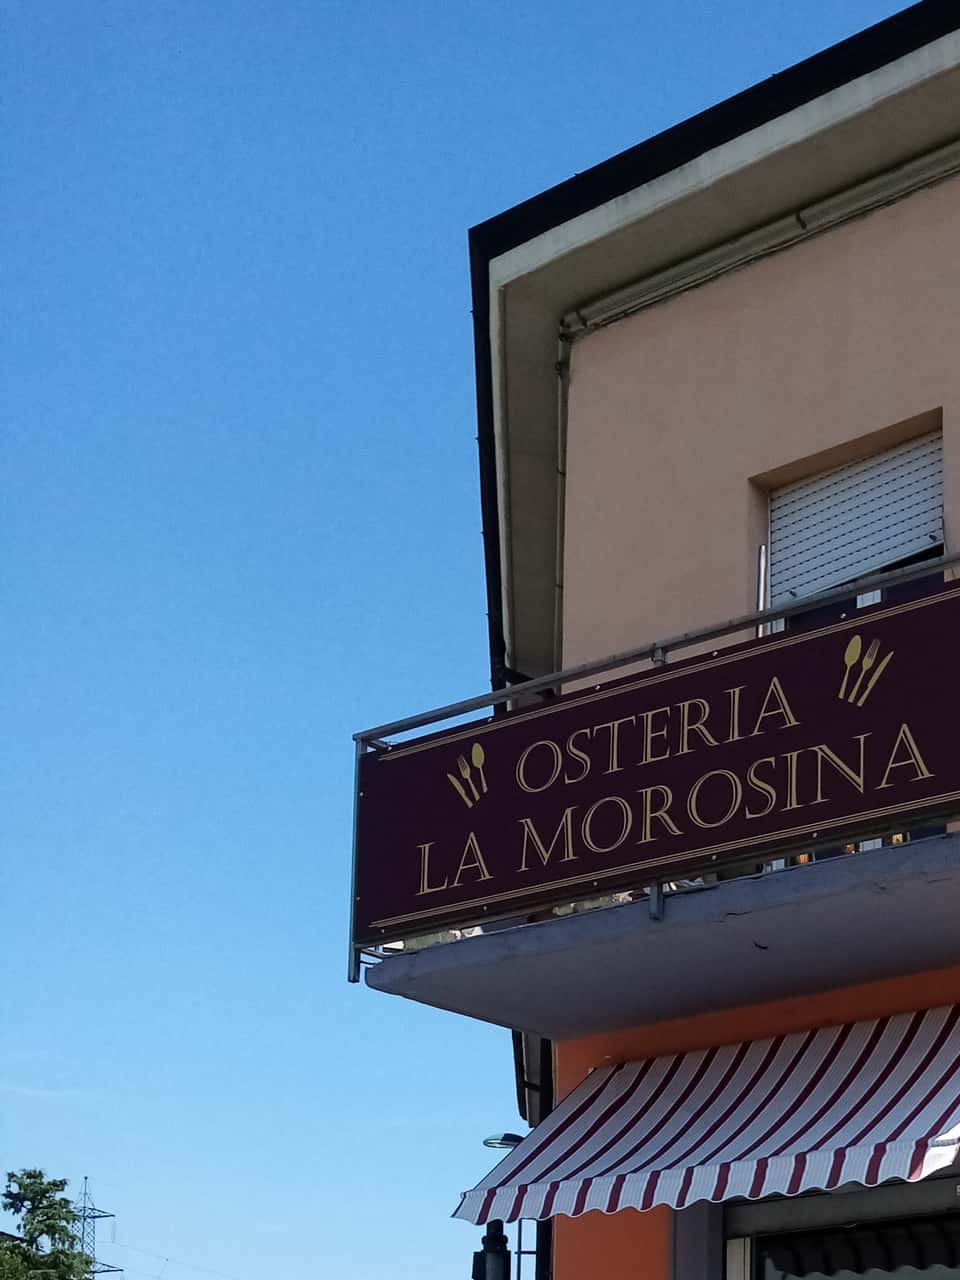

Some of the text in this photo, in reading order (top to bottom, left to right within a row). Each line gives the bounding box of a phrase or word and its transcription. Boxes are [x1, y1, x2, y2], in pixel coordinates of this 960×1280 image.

[513, 675, 802, 794] OSTERIA
[415, 722, 935, 896] LA MOROSINA
